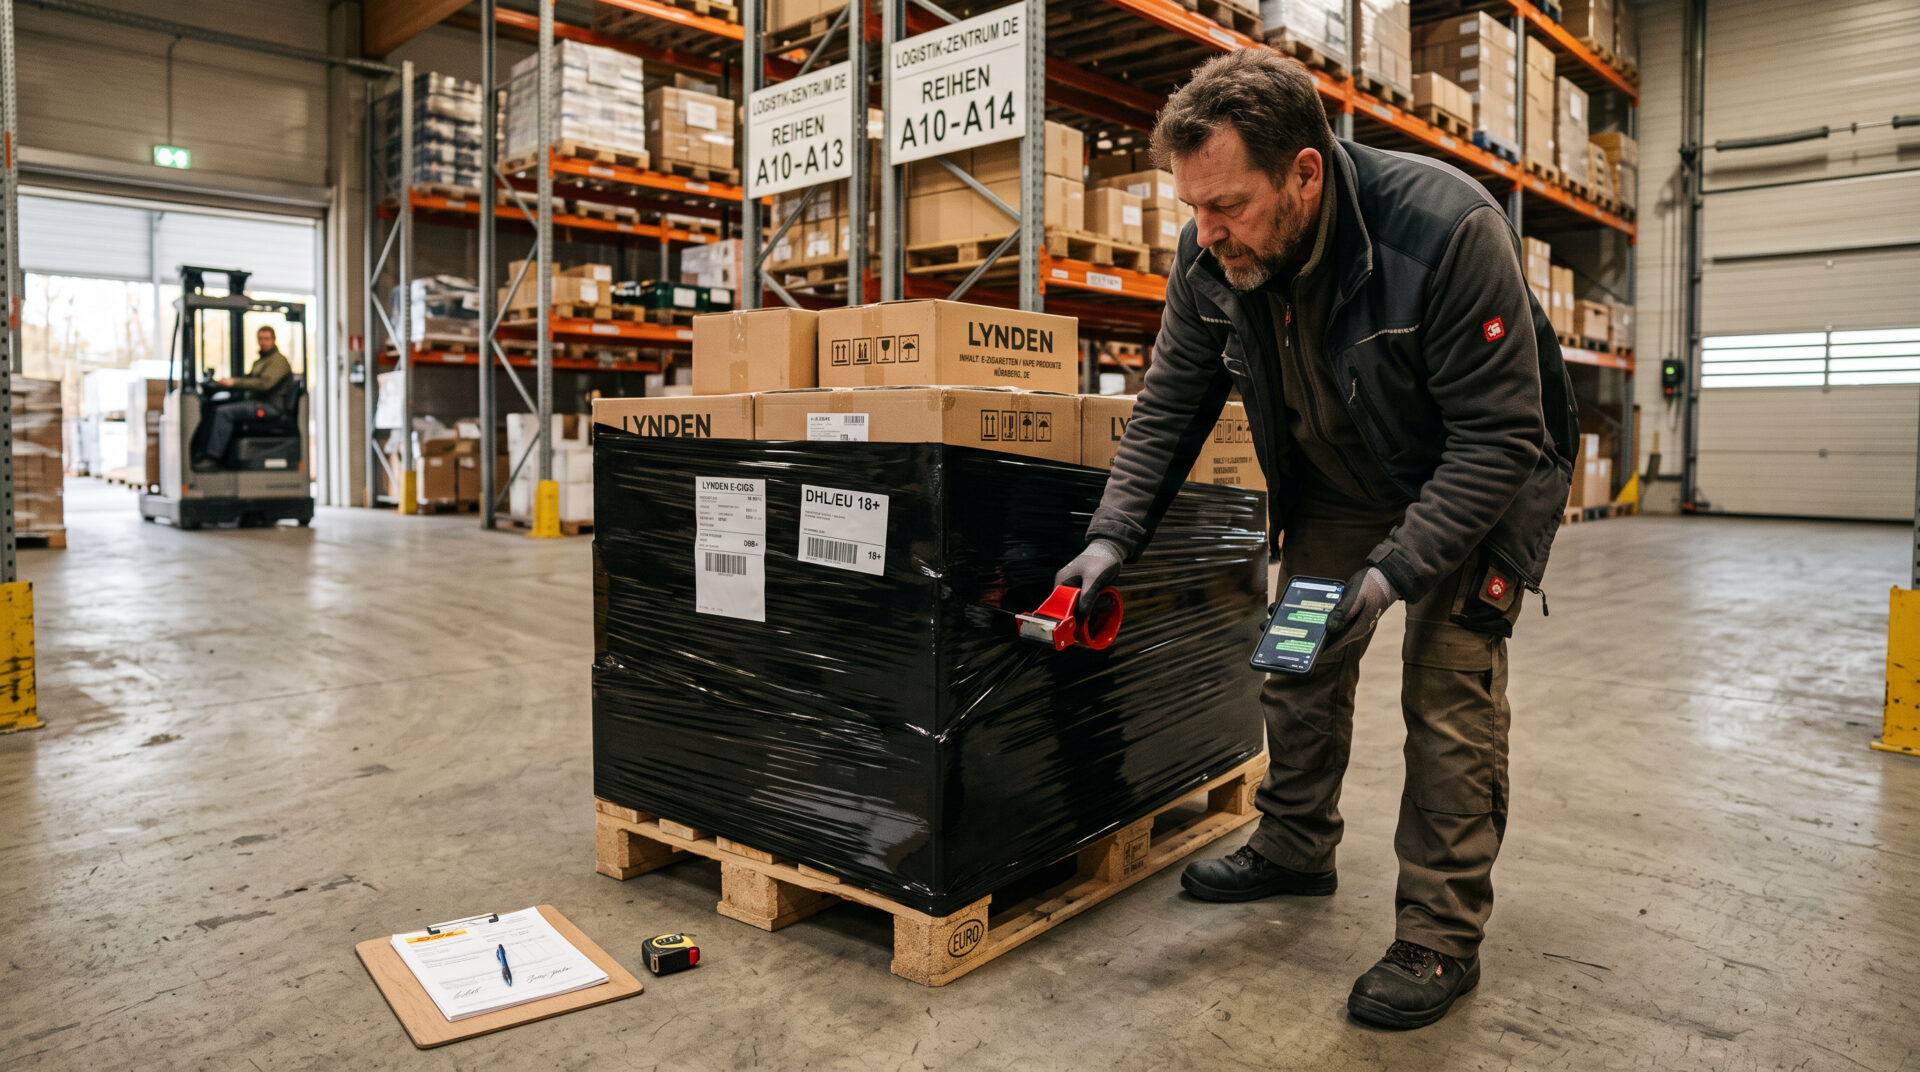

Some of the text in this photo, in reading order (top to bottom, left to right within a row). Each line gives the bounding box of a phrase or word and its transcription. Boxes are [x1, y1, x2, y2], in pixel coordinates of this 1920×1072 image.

[896, 16, 1019, 69] LOGISTIK-ZENTRUM DE
[753, 73, 847, 116] LOGISTIK-ZENTRUM DE
[922, 64, 990, 104] REIHEN
[772, 114, 824, 147] REIHEN
[900, 91, 1015, 150] A10-A14
[756, 138, 844, 187] A10-A13
[968, 321, 1053, 354] LYNDEN
[702, 481, 754, 492] LYNDEN E-CIGS
[805, 489, 880, 511] DHL/EU 18+
[868, 551, 881, 560] 18+
[953, 925, 979, 952] EURO
